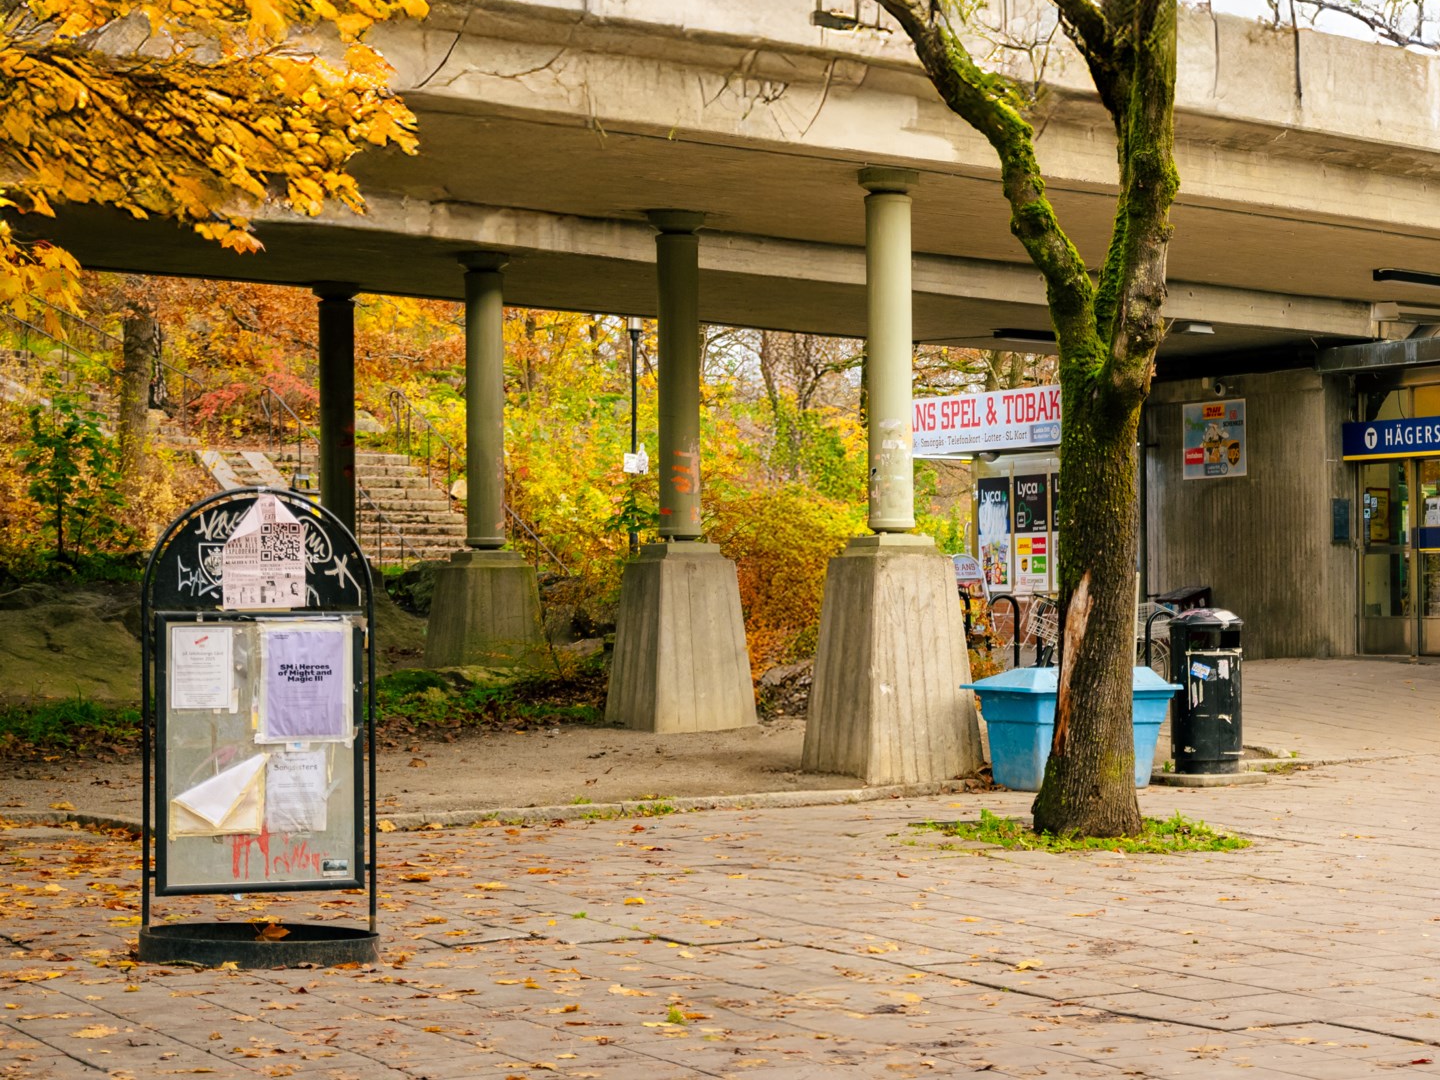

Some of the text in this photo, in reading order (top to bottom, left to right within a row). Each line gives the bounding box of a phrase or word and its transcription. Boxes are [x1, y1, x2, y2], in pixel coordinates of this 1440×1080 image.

[941, 399, 981, 430] SPEL
[986, 397, 998, 426] &
[1002, 390, 1061, 425] TOBAK
[921, 437, 944, 448] Smörgås
[947, 434, 980, 446] Telefonkort
[984, 432, 1002, 443] Lotter
[1005, 431, 1014, 441] SL
[1014, 430, 1028, 440] Kort
[981, 489, 1001, 503] Lyca
[1017, 481, 1038, 498] Lyca
[287, 676, 313, 684] Magic
[289, 670, 315, 678] Might
